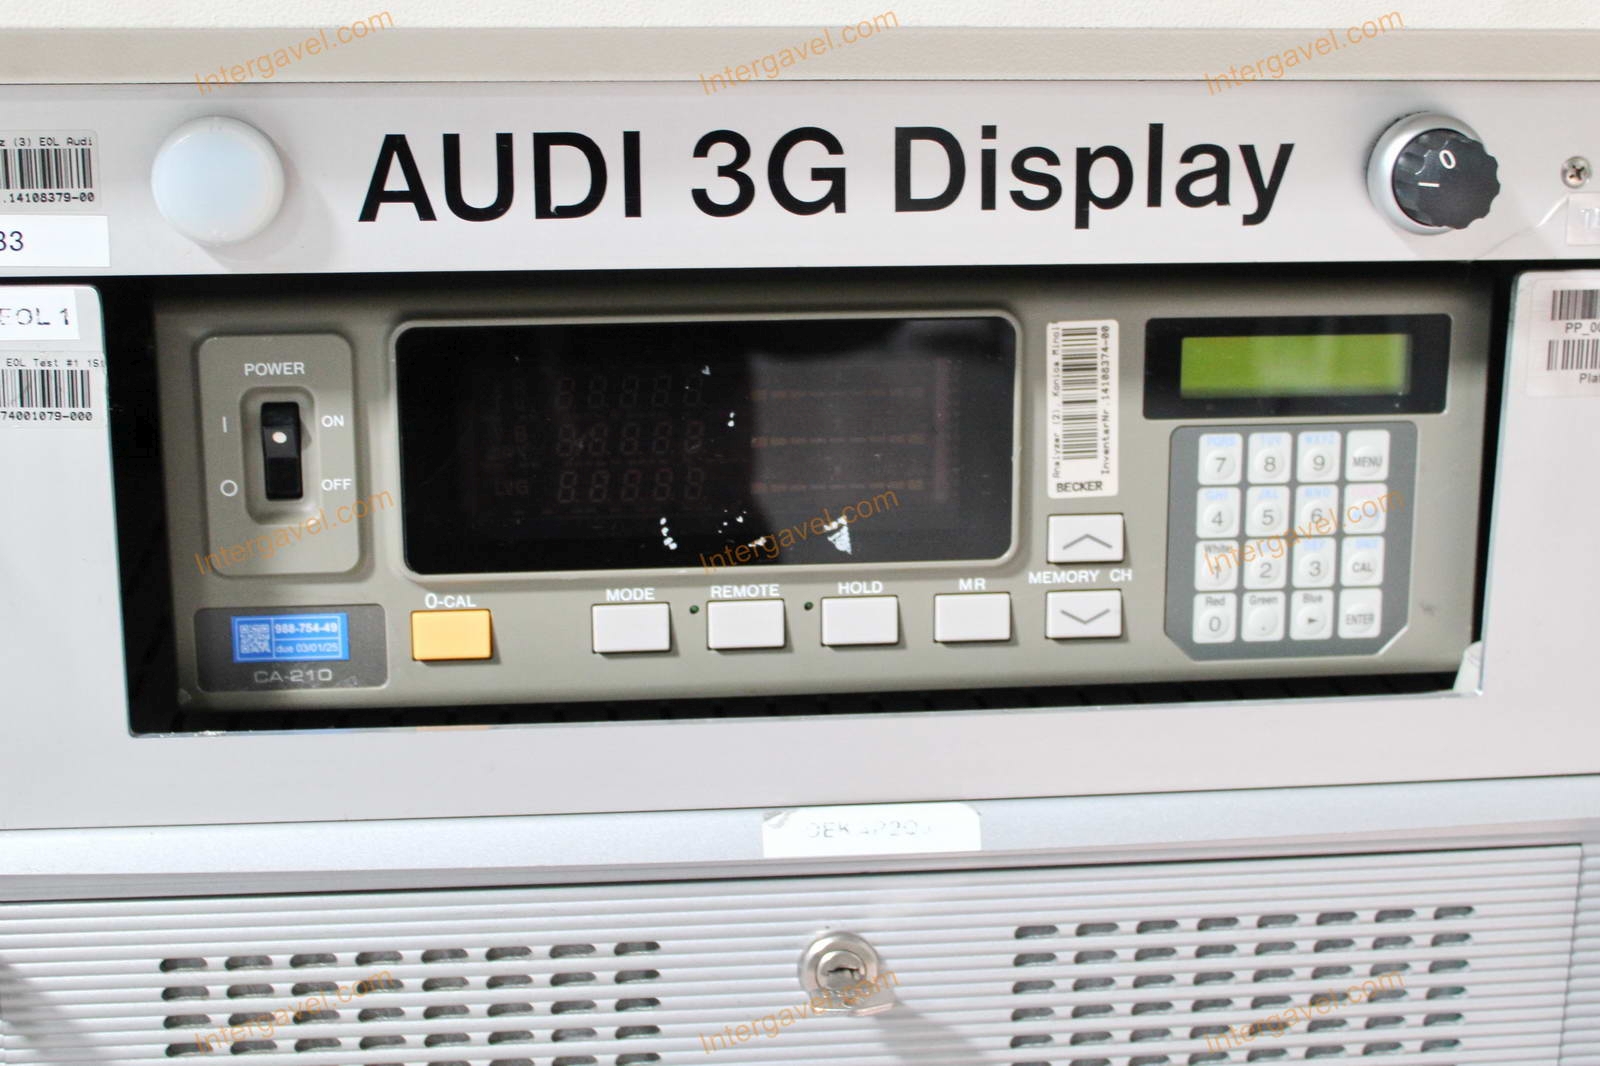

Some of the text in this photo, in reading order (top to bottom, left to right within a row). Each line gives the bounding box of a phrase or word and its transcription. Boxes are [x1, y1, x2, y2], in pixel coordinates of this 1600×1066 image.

[14, 137, 31, 147] (3)
[39, 136, 60, 147] EOL
[358, 123, 1295, 229] AUDI 3G Display
[33, 358, 59, 368] Test
[244, 362, 305, 376] POWER
[321, 415, 345, 428] ON
[1215, 457, 1227, 473] 7
[1263, 456, 1276, 472] 8
[1312, 455, 1326, 471] 9
[1352, 455, 1383, 468] MENU
[321, 478, 352, 491] OFF
[1056, 481, 1103, 493] BECKER
[1211, 511, 1223, 526] 4
[1261, 509, 1274, 525] 5
[1311, 508, 1323, 524] 6
[1260, 562, 1272, 578] 2
[1309, 561, 1321, 576] 3
[1352, 561, 1373, 573] CAL
[1028, 569, 1132, 584] MEMORY CH
[710, 584, 780, 598] REMOTE
[838, 581, 883, 594] HOLD
[959, 578, 987, 591] MR
[606, 588, 655, 601] MODE
[1248, 595, 1278, 606] Green
[1205, 597, 1226, 606] Red
[1346, 614, 1375, 625] ENTER
[254, 668, 333, 683] CA-210
